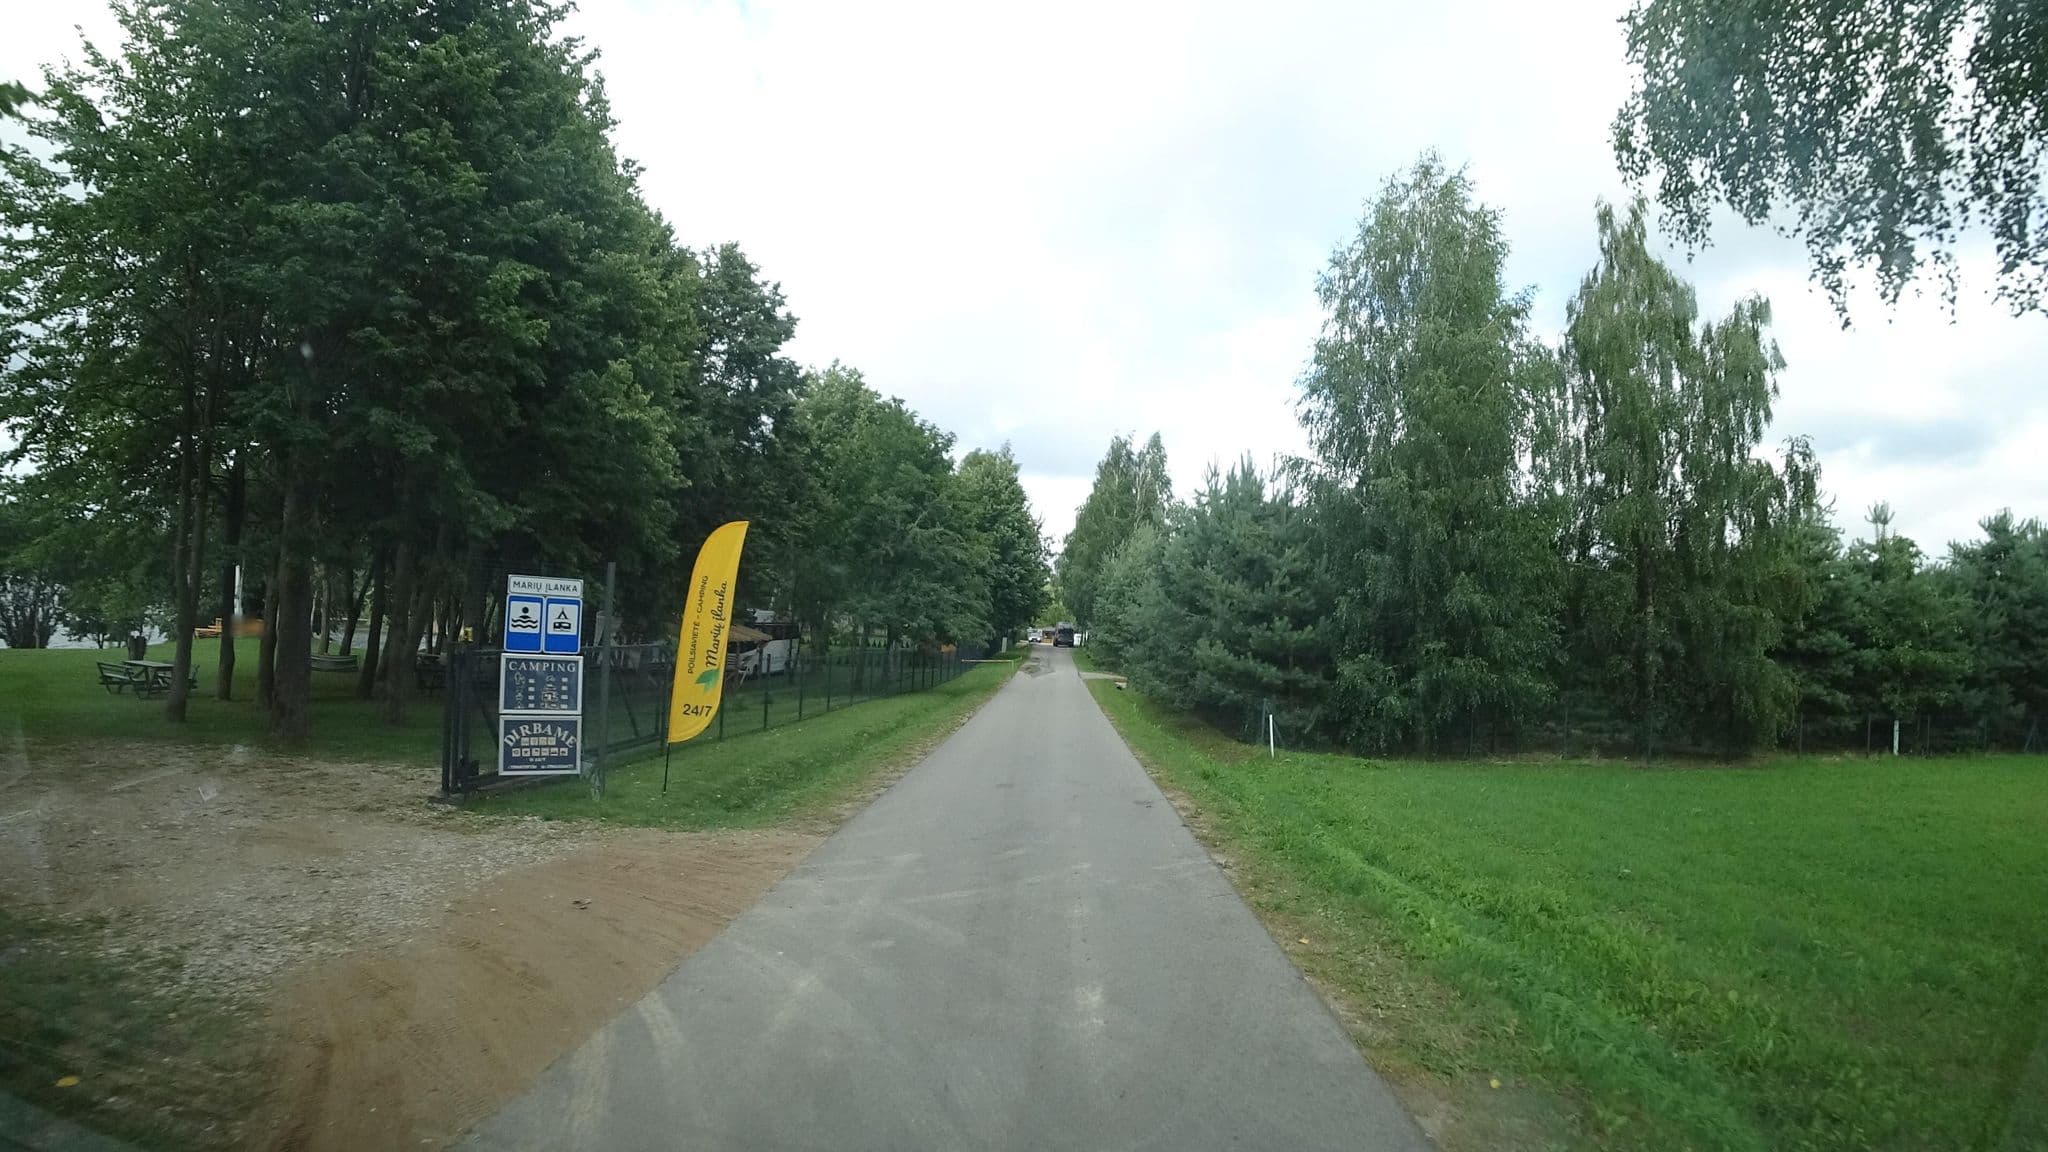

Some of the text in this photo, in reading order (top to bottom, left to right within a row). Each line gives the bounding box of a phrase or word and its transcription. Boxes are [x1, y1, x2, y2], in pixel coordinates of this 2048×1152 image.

[513, 581, 578, 593] MARIŲ ĮLANKA
[696, 575, 709, 614] CAMPING
[705, 624, 725, 668] Marių
[508, 661, 577, 673] CAMPING
[682, 703, 713, 718] 24/7
[504, 723, 577, 748] DIRBAME
